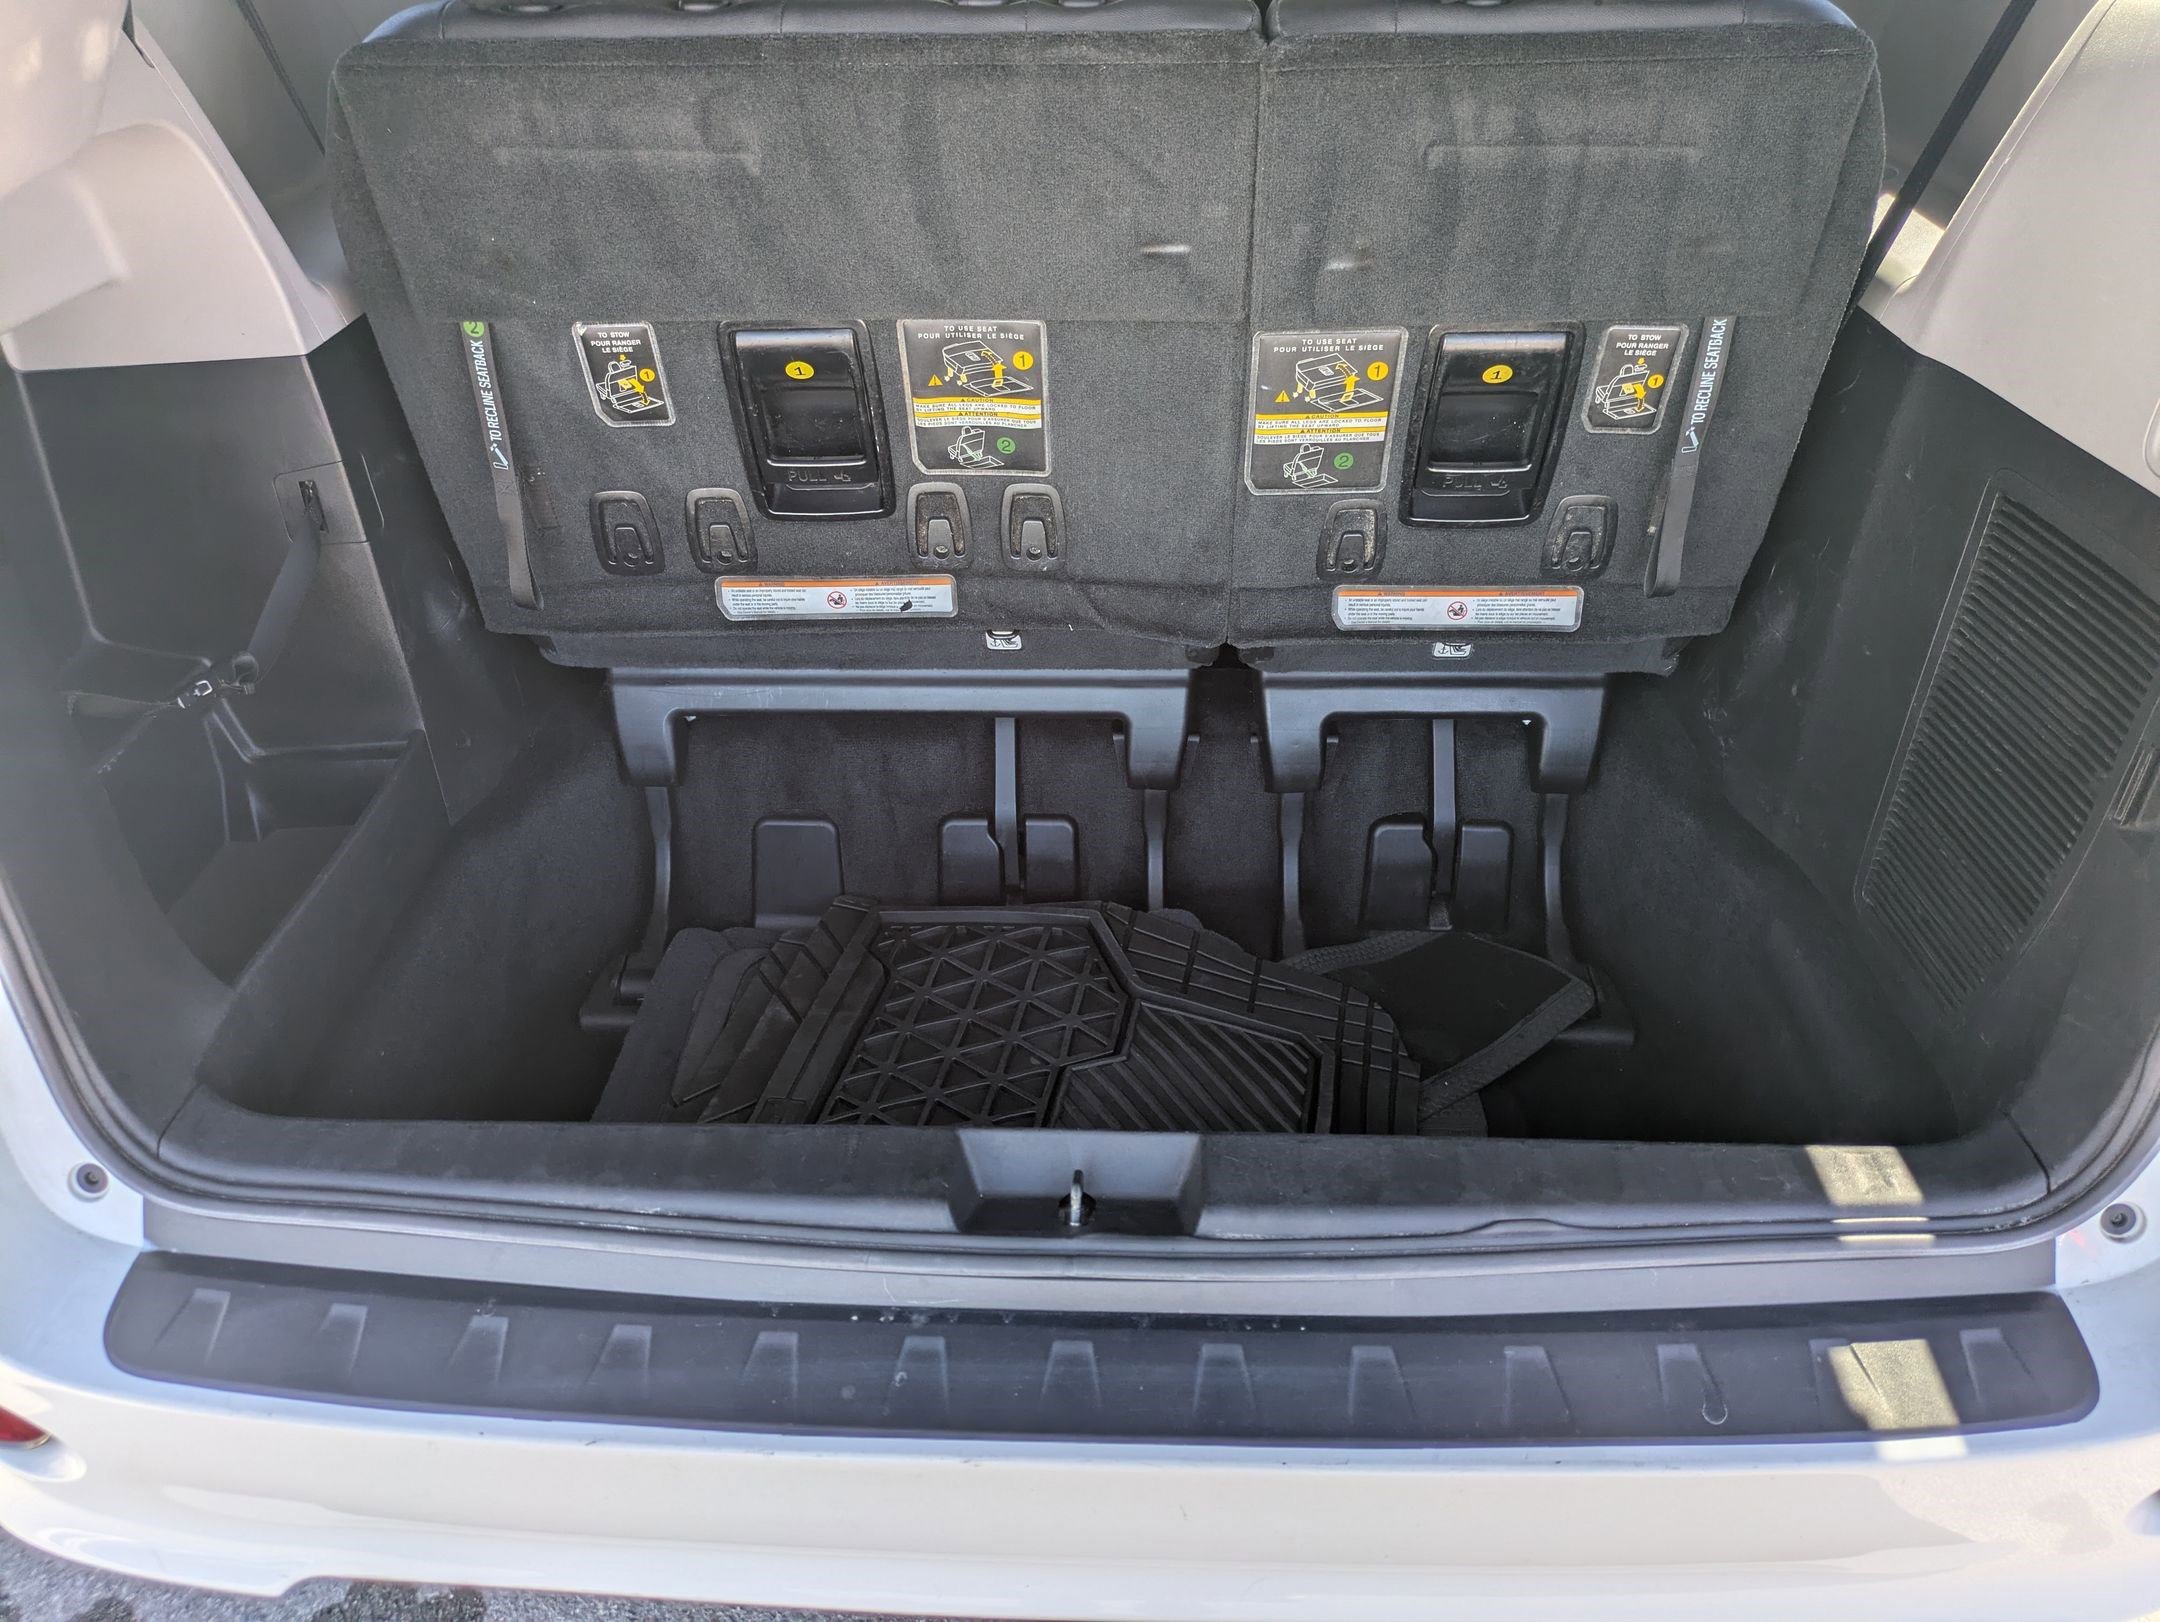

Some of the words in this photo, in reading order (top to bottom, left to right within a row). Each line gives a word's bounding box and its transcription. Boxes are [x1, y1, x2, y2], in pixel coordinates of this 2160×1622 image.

[1000, 332, 1024, 340] SIÈGE
[1638, 342, 1669, 350] RANGER
[1704, 318, 1728, 370] SEATBACK
[470, 340, 491, 389] SEATBACK
[1019, 354, 1025, 367] 1
[644, 371, 650, 380] 1
[794, 366, 806, 376] 1
[1374, 366, 1380, 378] 1
[1491, 370, 1502, 380] 1
[1653, 377, 1659, 386] 1
[1694, 371, 1716, 411] RECLINE
[480, 390, 499, 429] RECLINE
[1690, 412, 1706, 424] TO
[491, 428, 502, 441] TO
[1000, 440, 1011, 452] 2
[1339, 455, 1348, 467] 2
[788, 471, 827, 482] PULL
